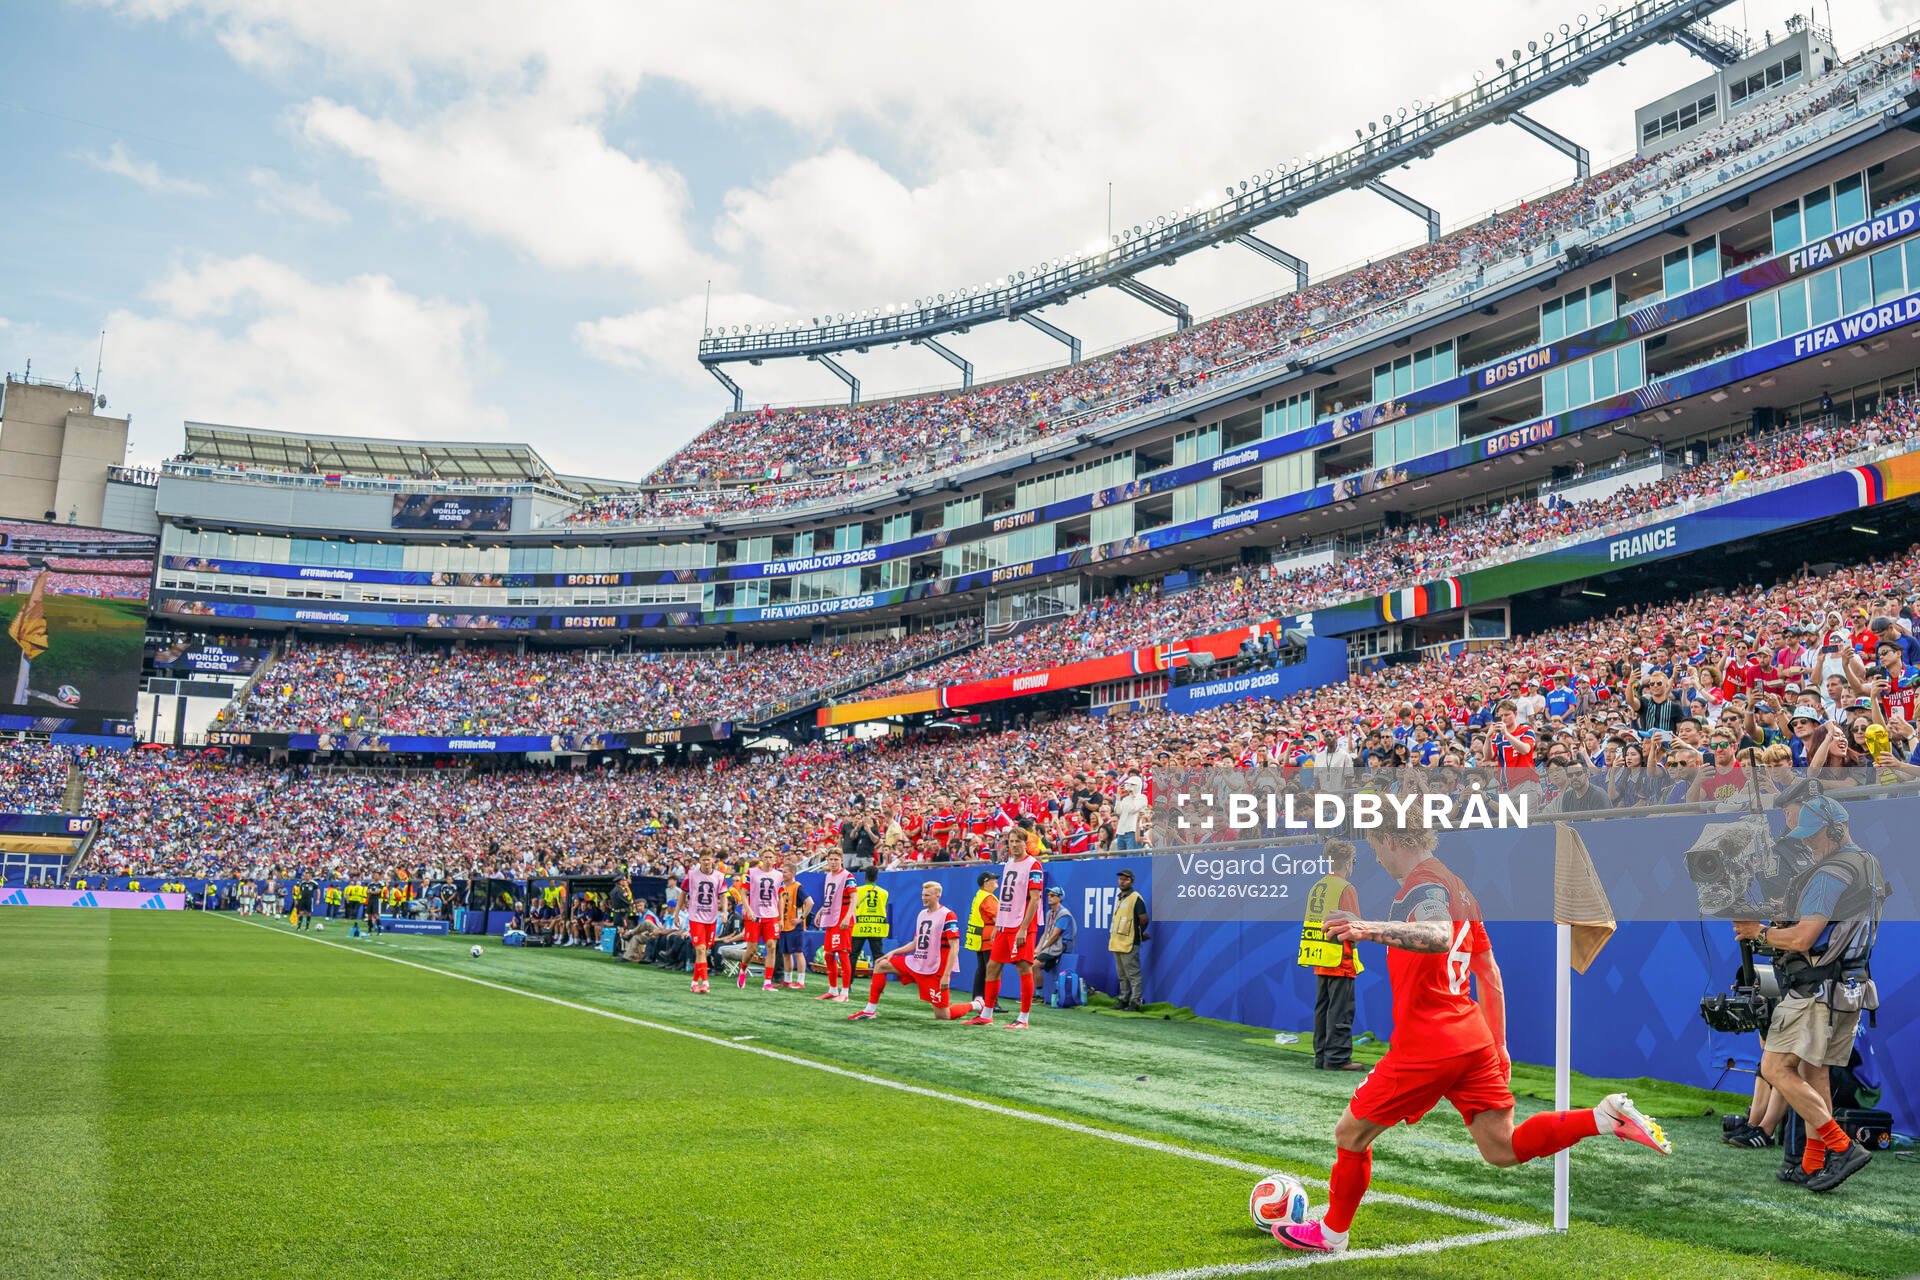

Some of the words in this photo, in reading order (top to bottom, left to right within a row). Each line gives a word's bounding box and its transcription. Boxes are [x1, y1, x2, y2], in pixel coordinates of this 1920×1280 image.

[1789, 241, 1833, 274] FIFA
[1835, 209, 1915, 255] WORLD
[1794, 326, 1840, 356] FIFA
[1842, 298, 1920, 340] WORLD
[1486, 348, 1550, 386] BOSTON
[1488, 420, 1552, 456] BOSTON
[1212, 450, 1258, 472] #FIFAWorldCup
[994, 511, 1034, 532] BOSTON
[1212, 510, 1258, 530] #FIFAWorldCup
[1610, 526, 1676, 562] FRANCE
[763, 562, 786, 574] FIFA
[787, 558, 820, 572] WORLD
[822, 554, 842, 568] CUP
[842, 550, 876, 564] 2026
[992, 562, 1034, 582] BOSTON
[300, 568, 354, 580] #FIFAWorldCup
[568, 574, 619, 584] BOSTON
[296, 610, 349, 622] #FIFAWorldCup
[760, 608, 784, 619] FIFA
[784, 603, 820, 617] WORLD
[820, 600, 840, 612] CUP
[840, 596, 874, 610] 2026
[564, 616, 616, 628] BOSTON
[187, 653, 220, 662] WORLD
[204, 646, 223, 654] FIFA
[196, 662, 227, 670] 2026
[1013, 672, 1049, 691] NORWAY
[1190, 688, 1206, 699] FIFA
[1206, 682, 1234, 696] WORLD
[1234, 678, 1250, 692] CUP
[1250, 672, 1279, 688] 2026
[206, 734, 250, 744] STON
[646, 730, 681, 744] BOSTON
